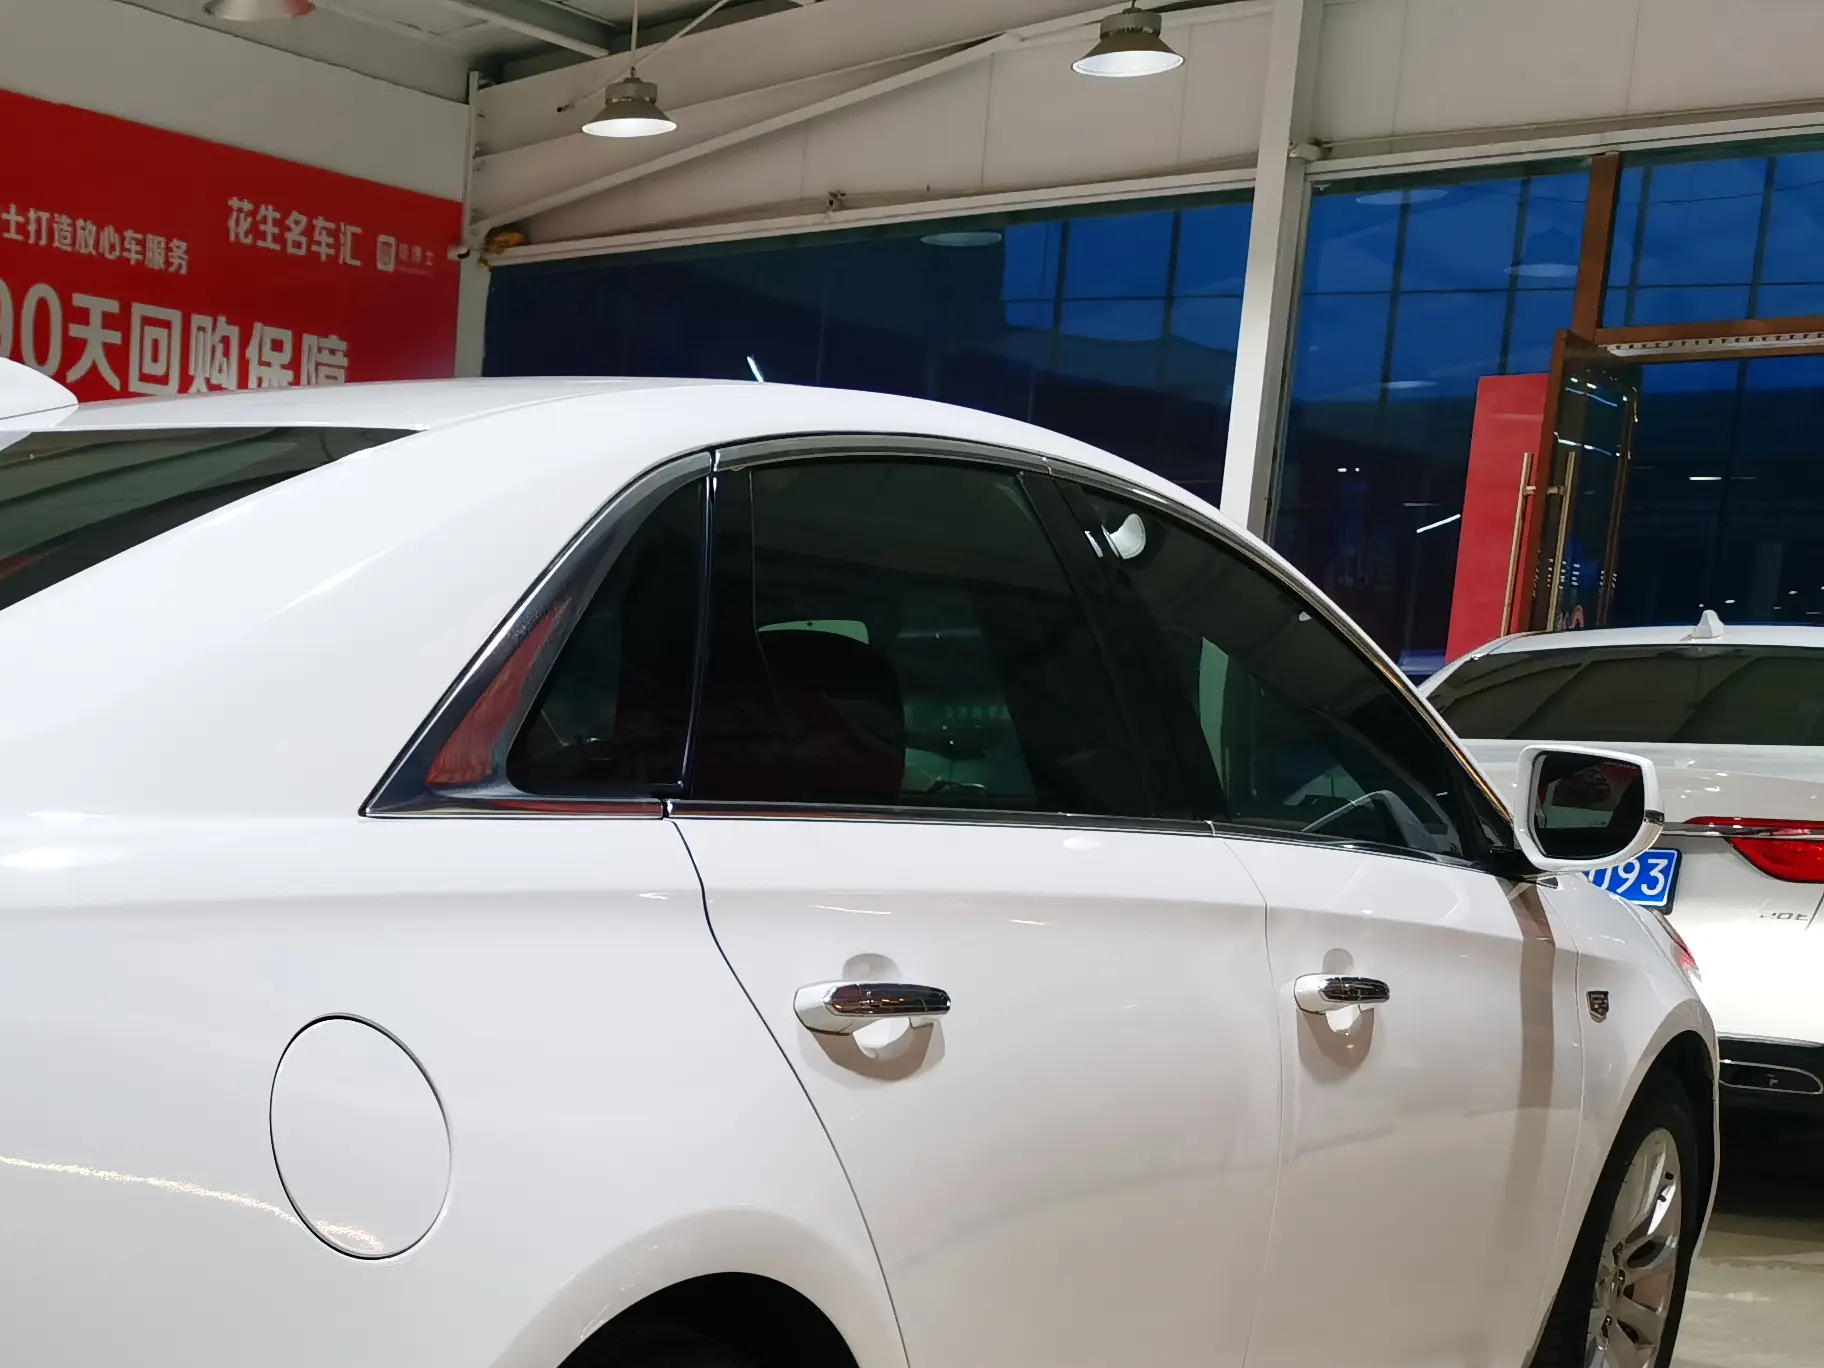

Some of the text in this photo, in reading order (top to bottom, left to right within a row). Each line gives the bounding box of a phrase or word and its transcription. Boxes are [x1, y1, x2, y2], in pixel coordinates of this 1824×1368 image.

[227, 196, 362, 266] 花生名车汇
